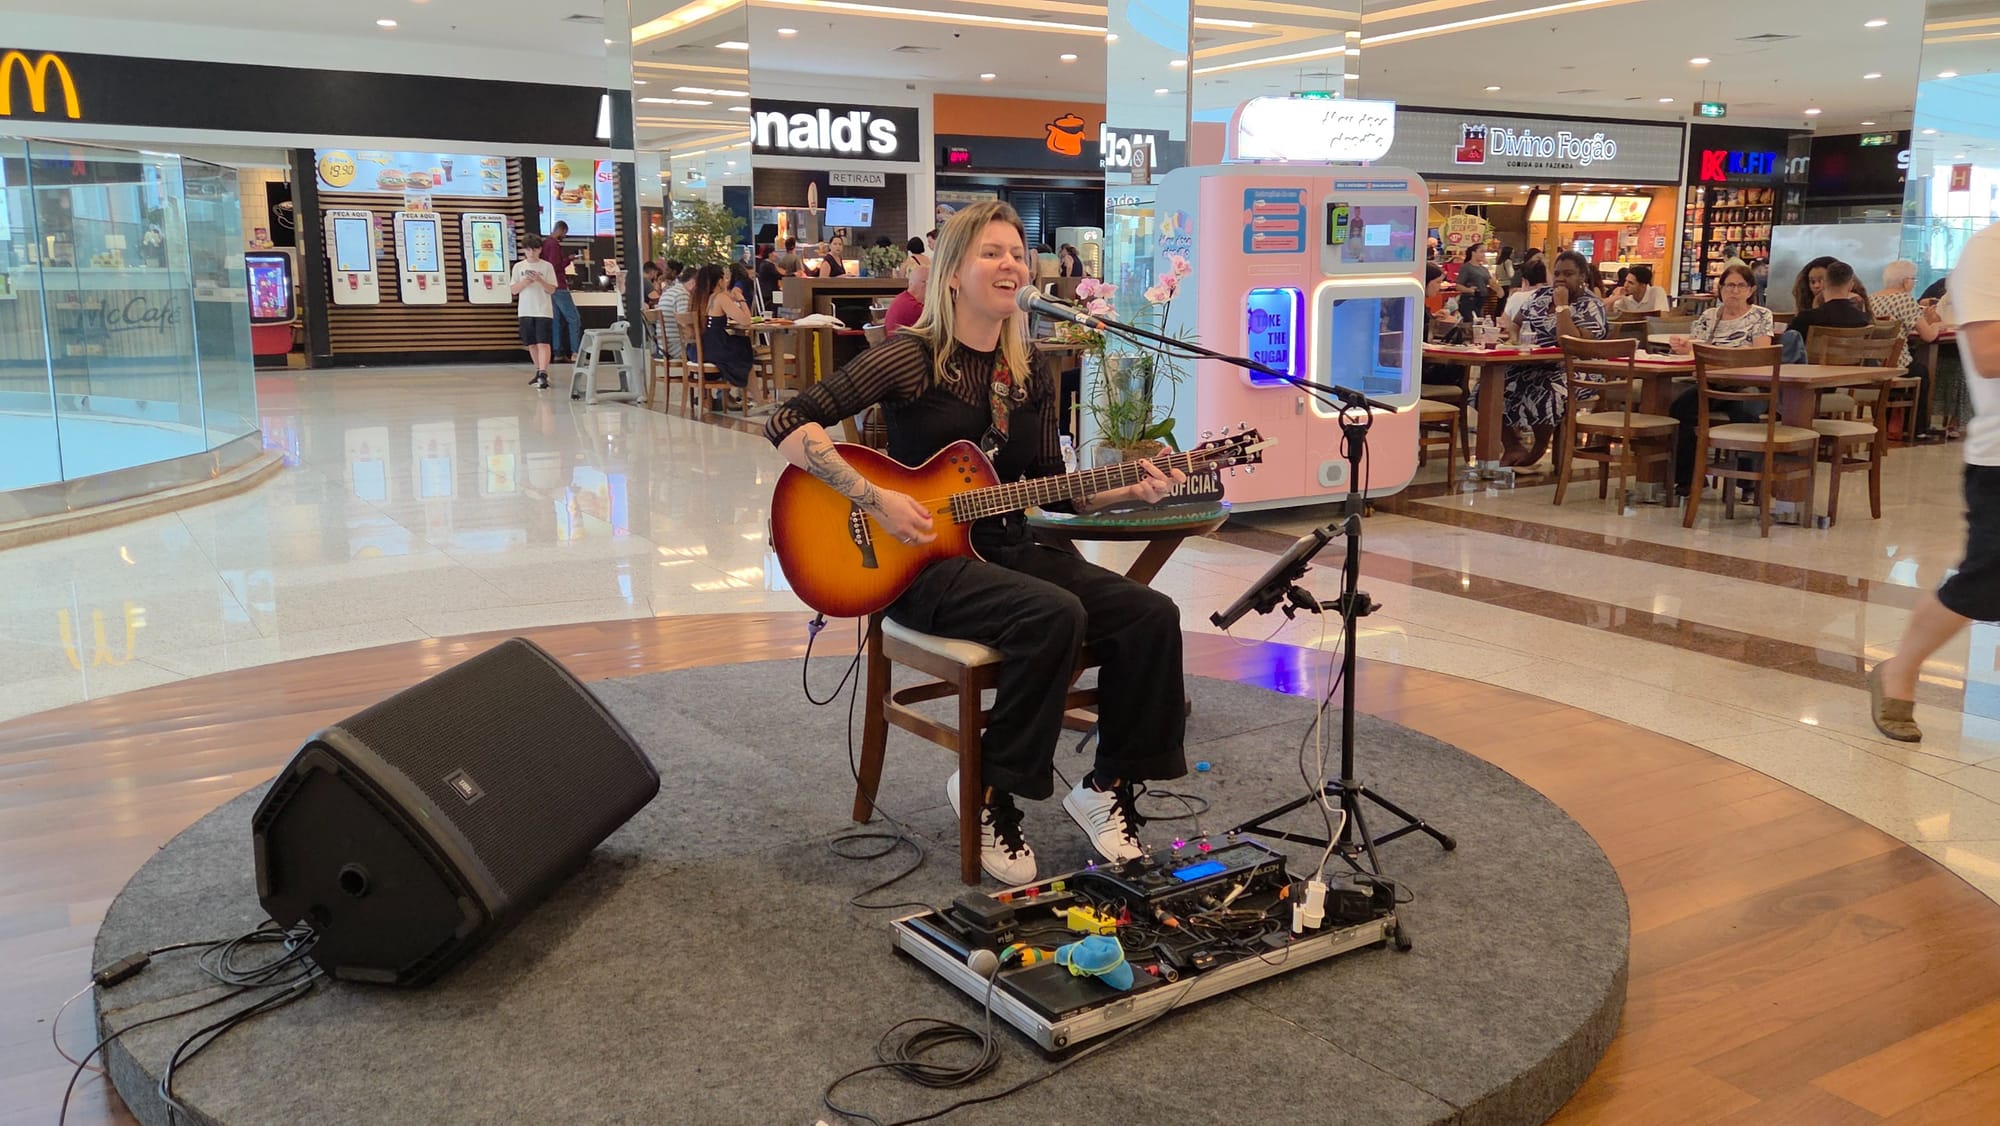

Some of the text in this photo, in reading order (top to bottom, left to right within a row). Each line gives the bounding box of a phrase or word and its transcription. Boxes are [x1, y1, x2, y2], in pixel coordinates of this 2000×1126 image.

[751, 108, 898, 154] nald's
[1490, 127, 1617, 166] Divino Fogão
[833, 173, 881, 184] RETIRADA
[1268, 332, 1286, 345] THE
